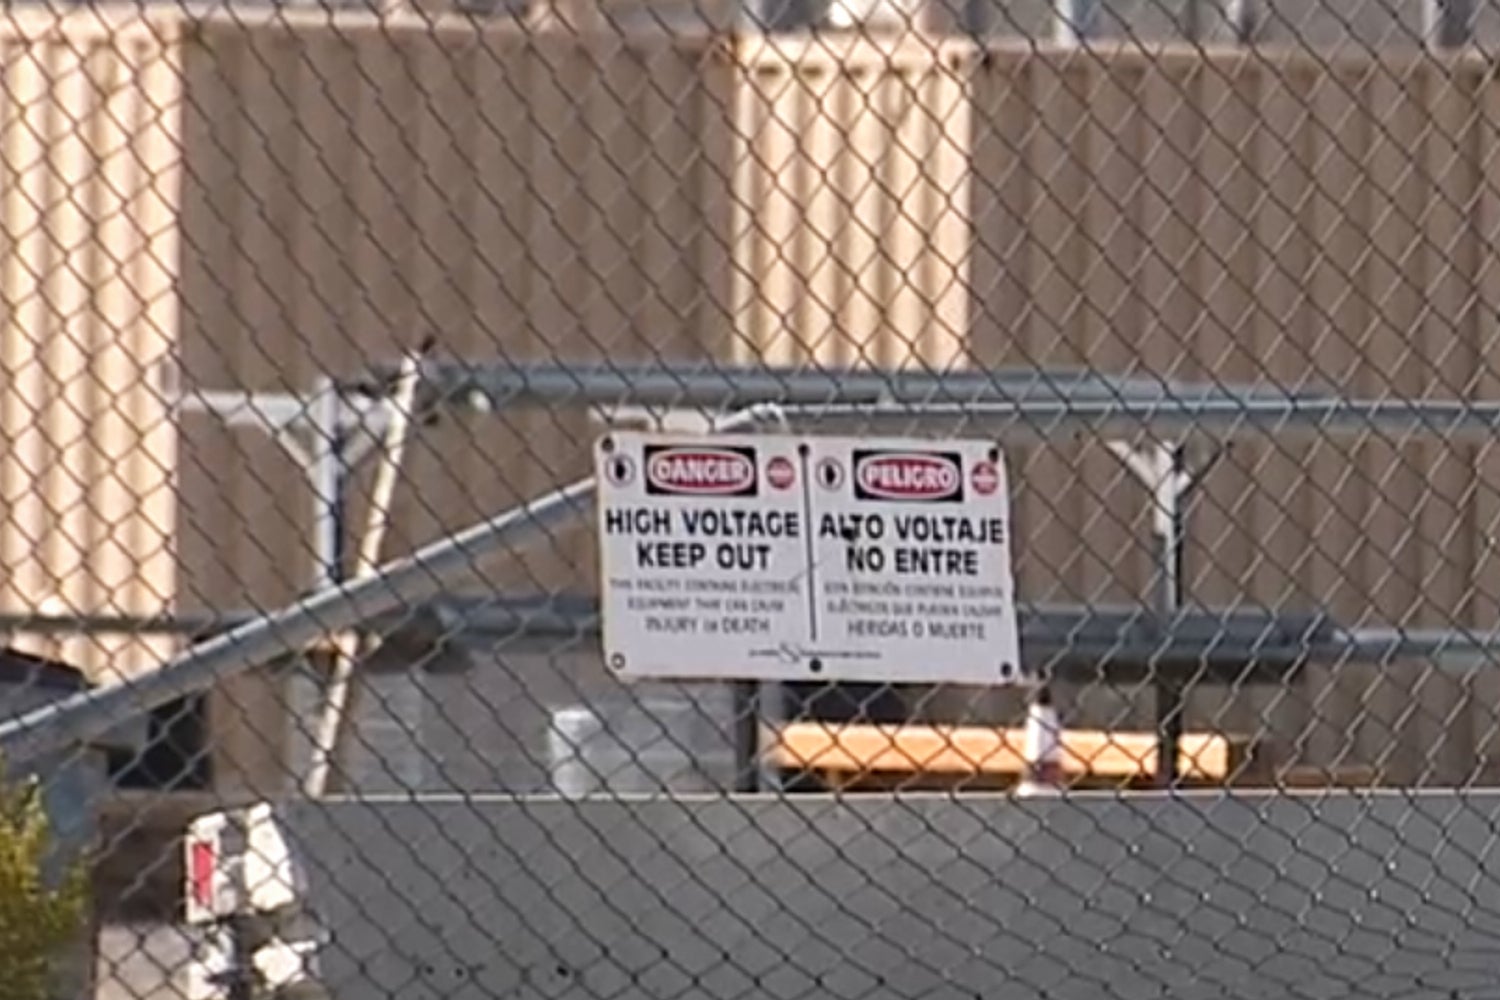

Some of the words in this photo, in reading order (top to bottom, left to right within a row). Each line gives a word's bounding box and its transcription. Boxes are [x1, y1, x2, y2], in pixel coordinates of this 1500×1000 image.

[656, 457, 748, 483] DANGER
[866, 464, 954, 490] PELIGRO
[606, 509, 671, 535] HIGH
[682, 510, 799, 537] VOLTAGE
[820, 513, 884, 541] ALTO
[894, 516, 1004, 544] VOLTAJE
[637, 542, 705, 568] KEEP
[717, 544, 771, 570] OUT
[847, 547, 885, 573] NO
[895, 548, 978, 575] ENTRE
[645, 617, 697, 633] INJURY
[722, 618, 771, 633] DEATH
[848, 620, 908, 637] HERIDAS
[912, 621, 924, 637] O
[928, 622, 985, 639] MUERTE
